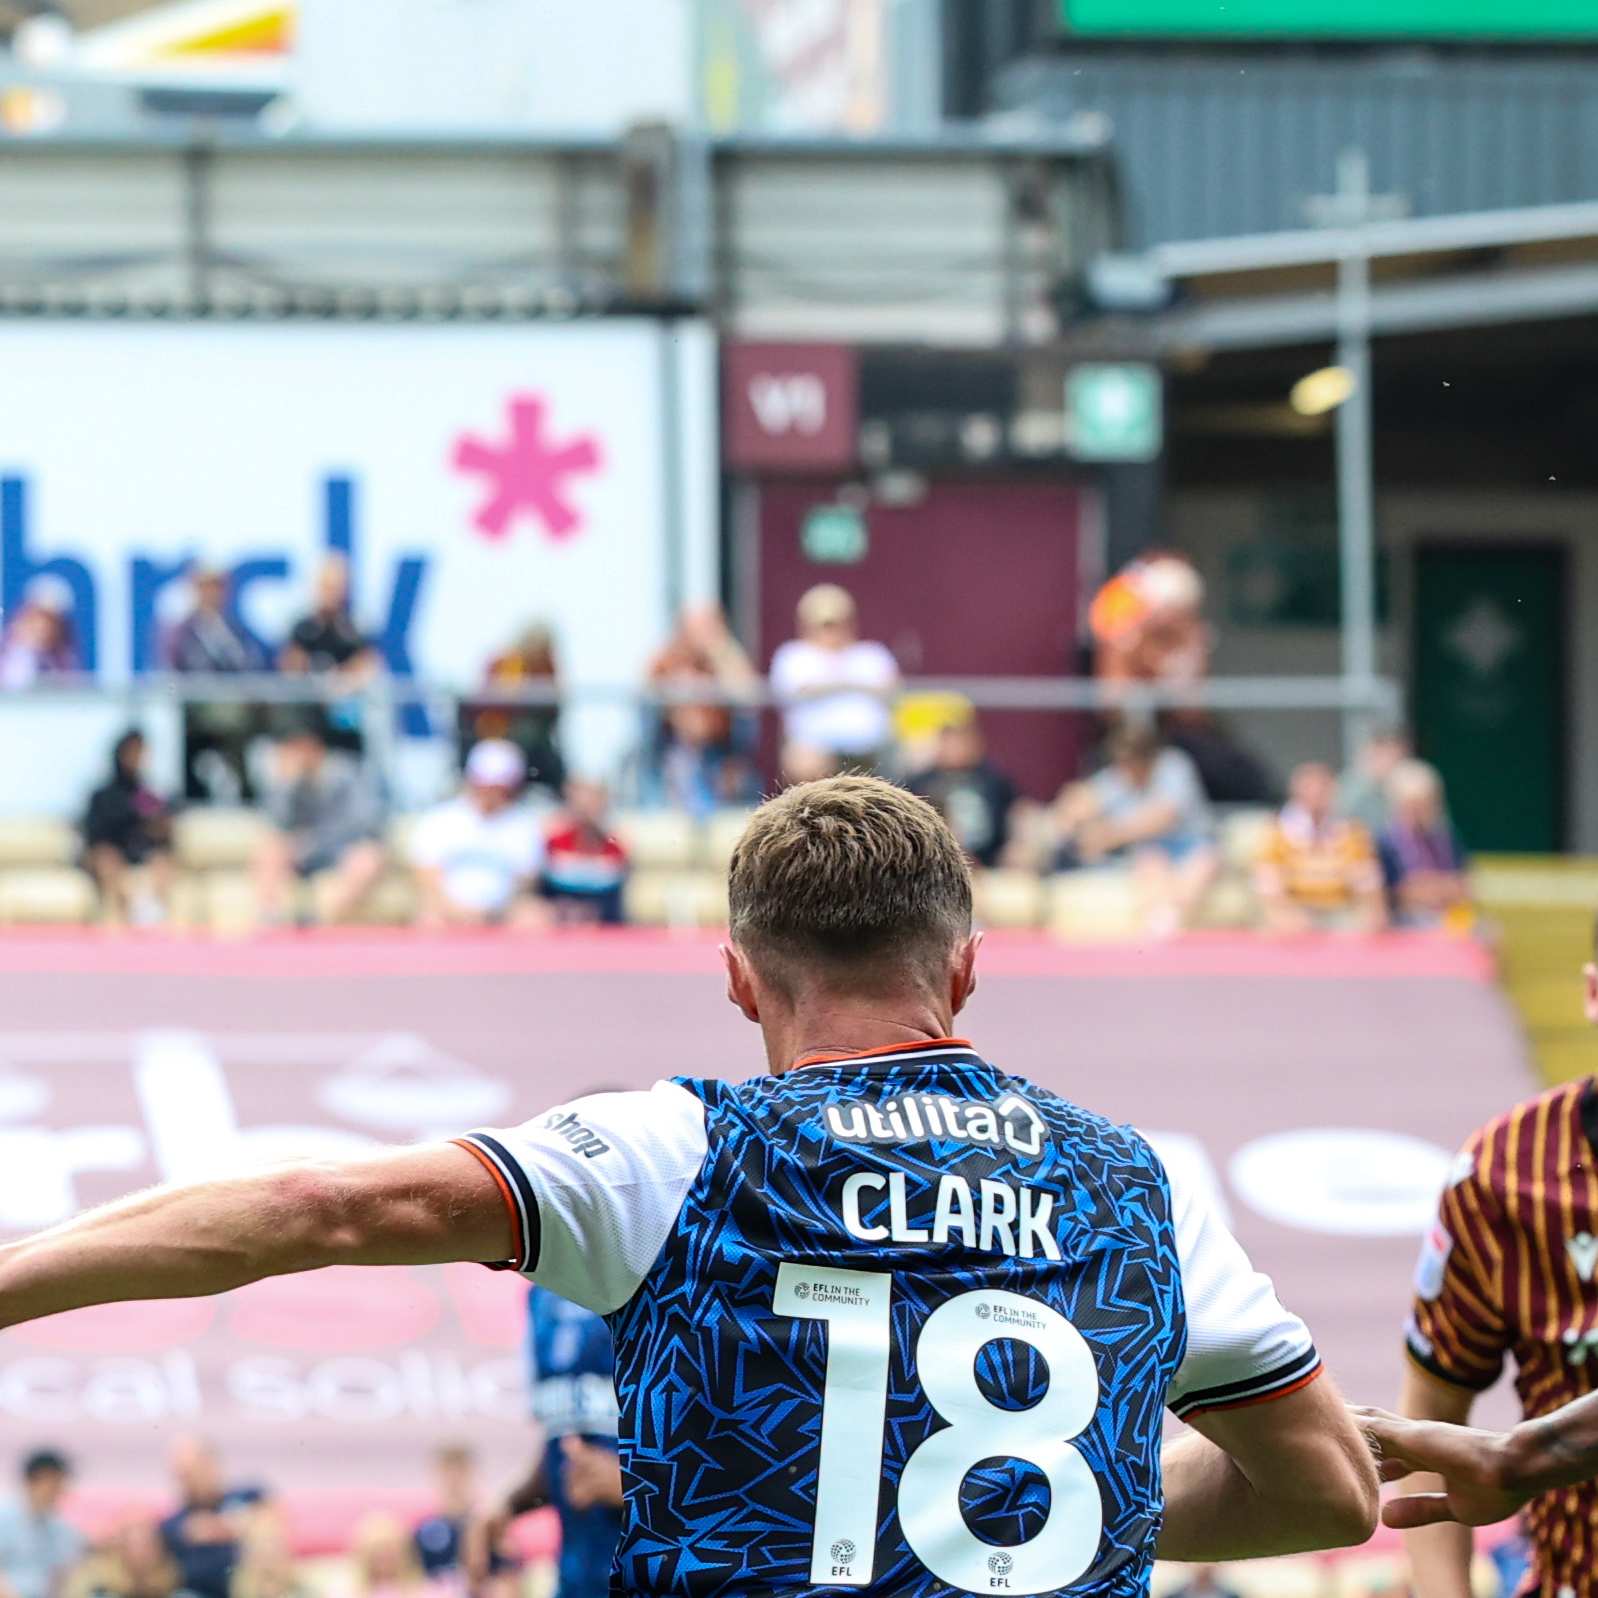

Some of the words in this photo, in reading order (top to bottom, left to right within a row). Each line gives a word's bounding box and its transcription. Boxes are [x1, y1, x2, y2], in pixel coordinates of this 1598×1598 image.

[827, 1097, 1001, 1144] utilita
[842, 1172, 1062, 1261] CLARK
[813, 1283, 829, 1294] EFL
[843, 1286, 861, 1297] THE
[812, 1293, 871, 1307] COMMUNITY
[993, 1305, 1008, 1316] EFL
[1020, 1309, 1038, 1320] THE
[992, 1314, 1047, 1331] COMMUNITY
[772, 1261, 1103, 1597] 18
[831, 1566, 853, 1577] EFL
[989, 1577, 1011, 1588] EFL
